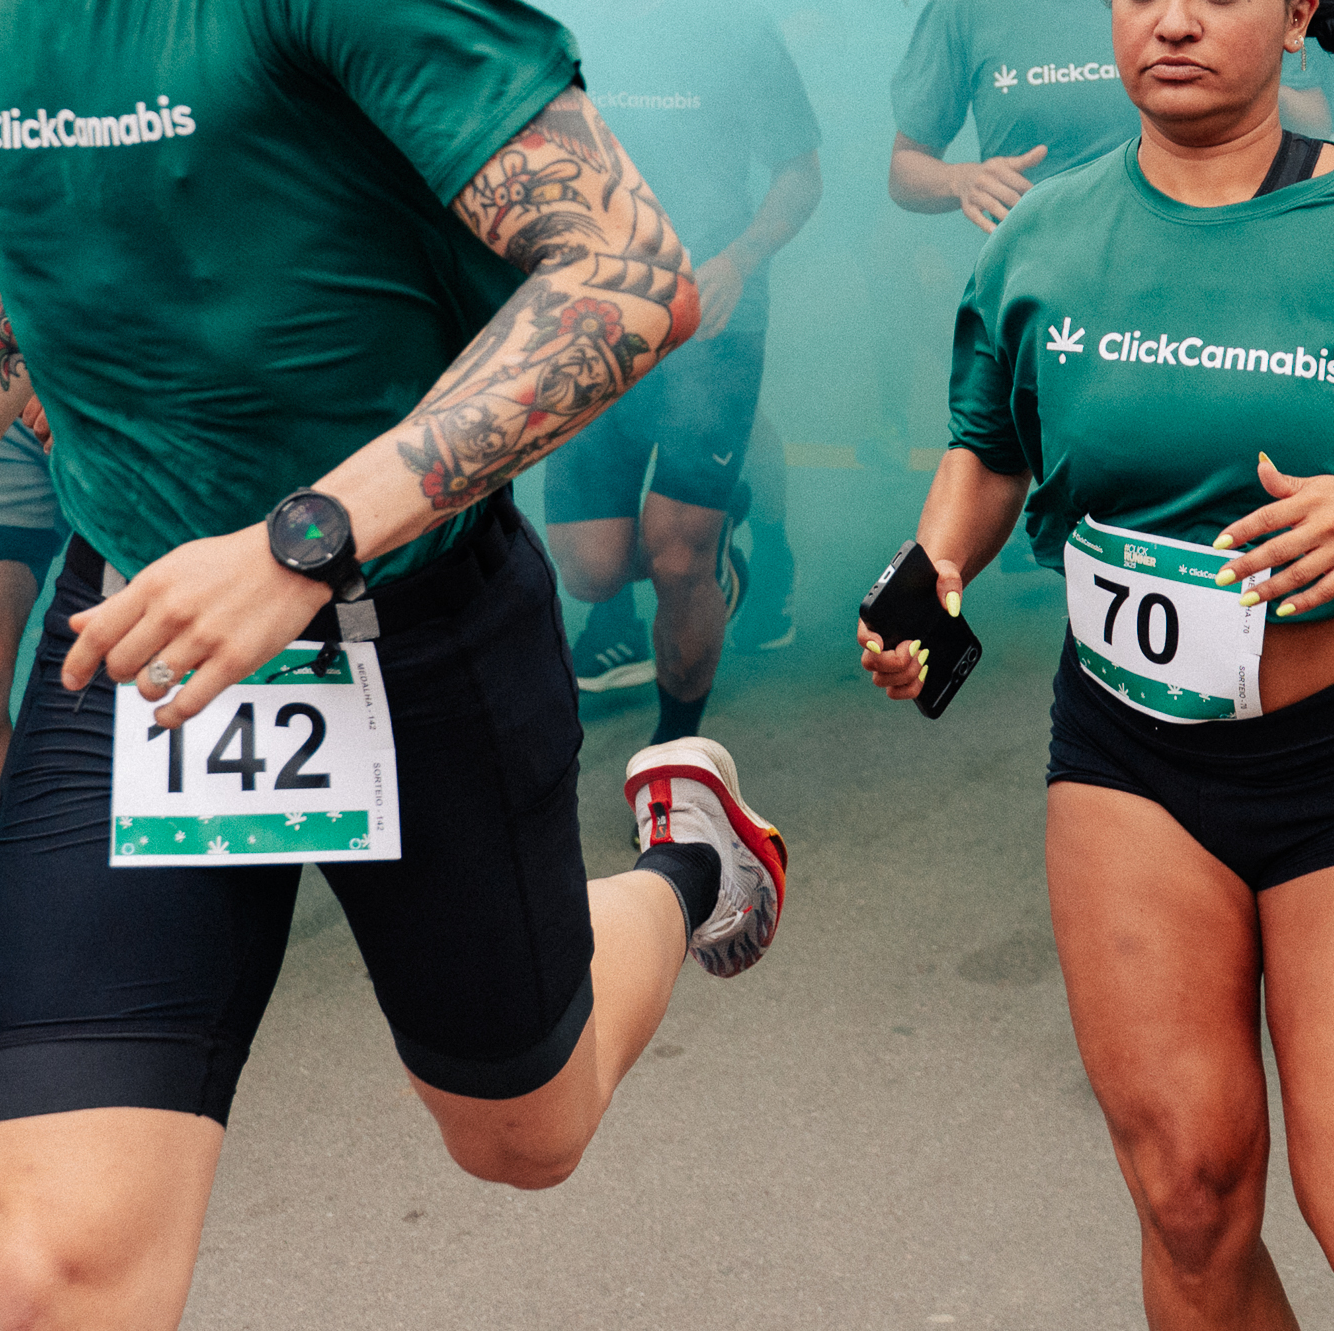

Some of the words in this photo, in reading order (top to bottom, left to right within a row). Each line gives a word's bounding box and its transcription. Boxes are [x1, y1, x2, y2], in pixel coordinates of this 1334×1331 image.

[1093, 573, 1180, 665] 70
[357, 663, 373, 707] MEDALHA
[147, 701, 331, 793] 142
[373, 762, 384, 807] SORTEIO
[376, 816, 385, 831] 142
